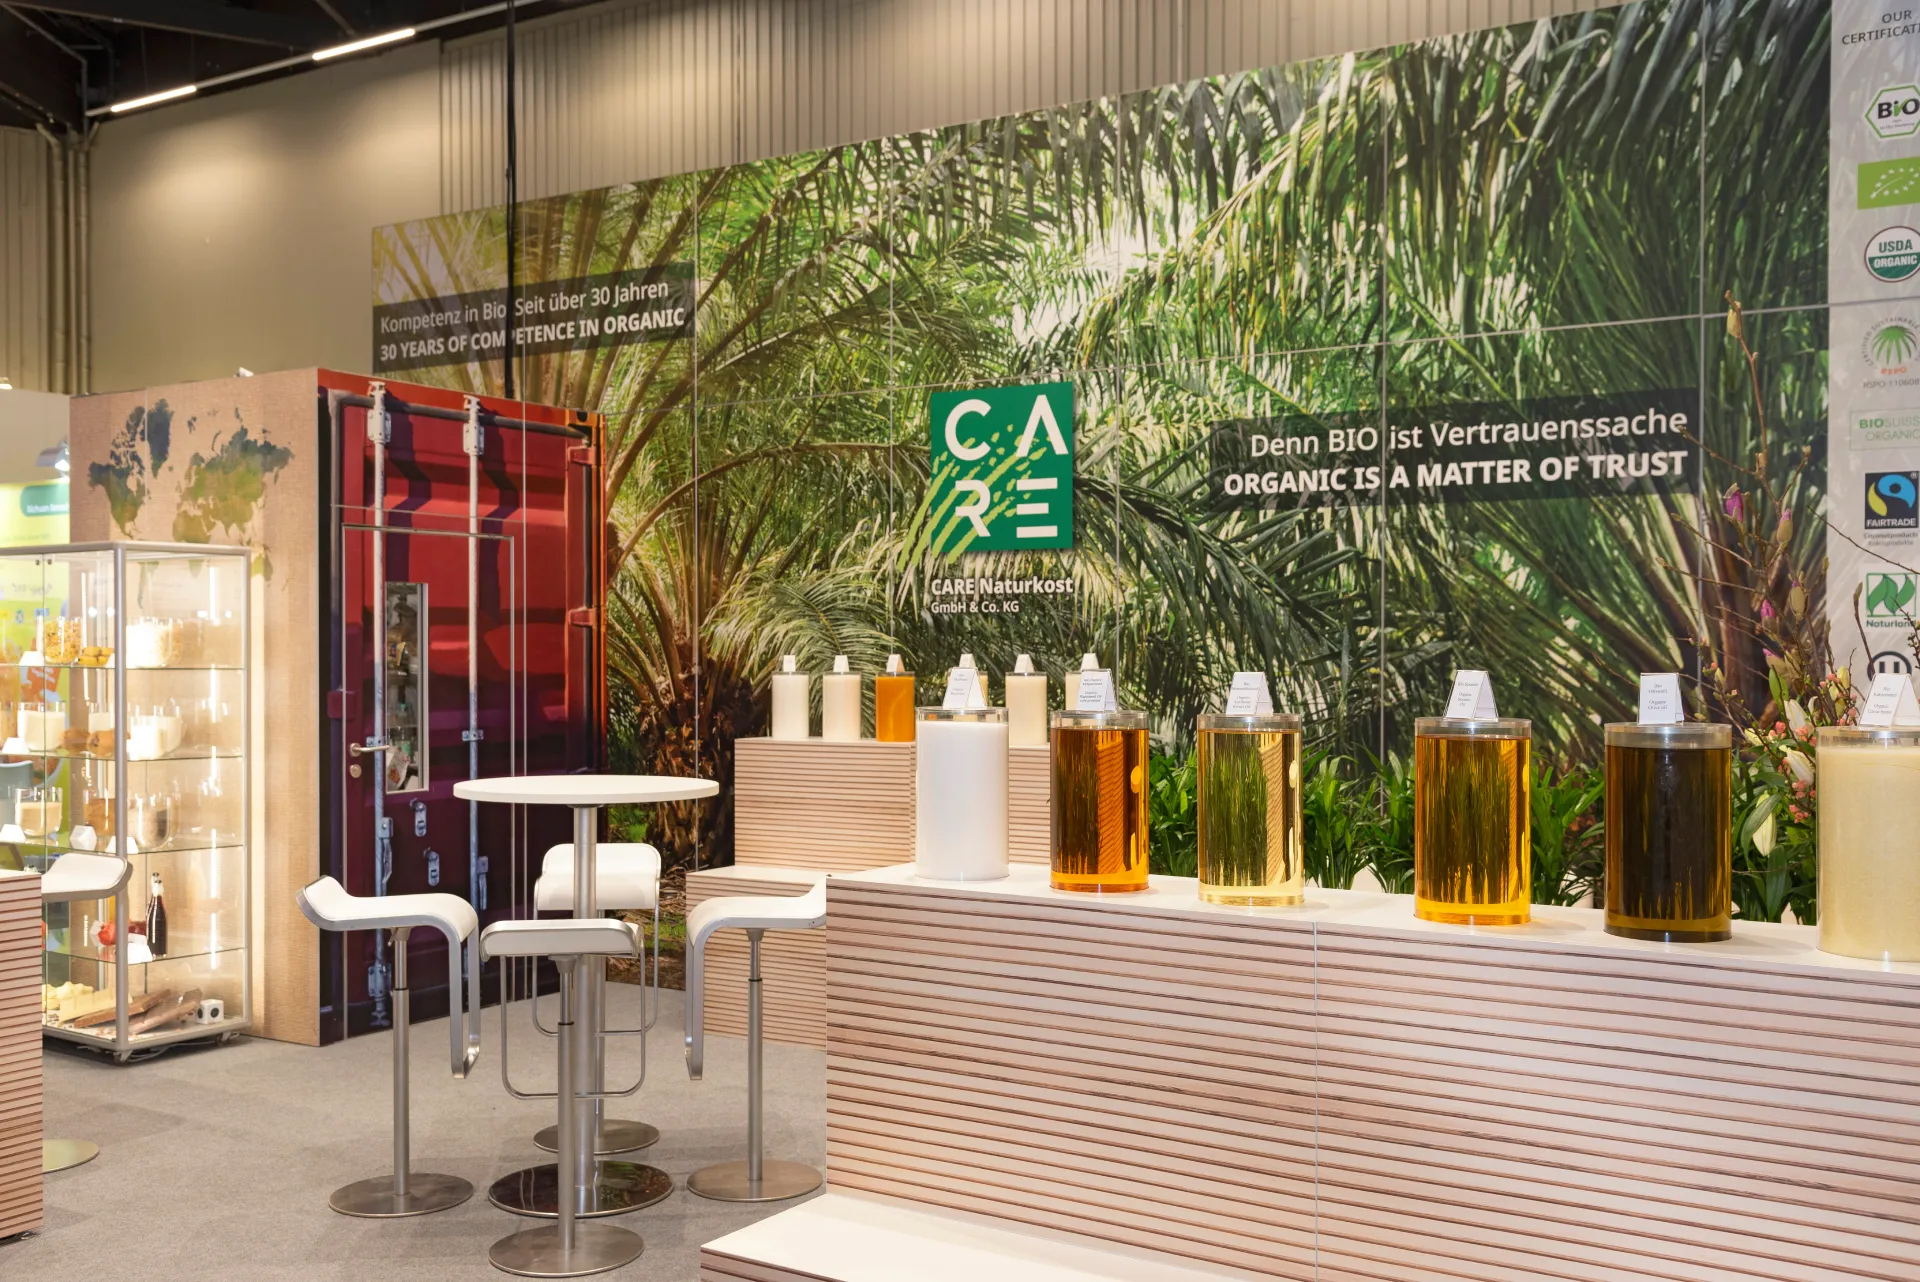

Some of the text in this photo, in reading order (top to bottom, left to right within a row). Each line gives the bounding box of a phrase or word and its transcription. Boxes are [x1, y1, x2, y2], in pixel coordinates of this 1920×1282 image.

[1881, 10, 1912, 24] OUR
[1878, 239, 1913, 253] USDA
[1873, 255, 1918, 269] ORGANIC
[380, 281, 669, 335] Kompetenz in Bio Seit über 30 Jahren
[380, 307, 685, 361] 30 YEARS OF COMETENCE IN ORGANIC
[1251, 407, 1688, 457] Denn BIO ist Vertrauenssache
[1224, 451, 1688, 496] ORGANIC IS A MATTER OF TRUST
[1866, 517, 1917, 528] FAIRTRADE
[931, 576, 1074, 595] CARE Naturkost
[931, 601, 1020, 614] GmbH & Co. KG
